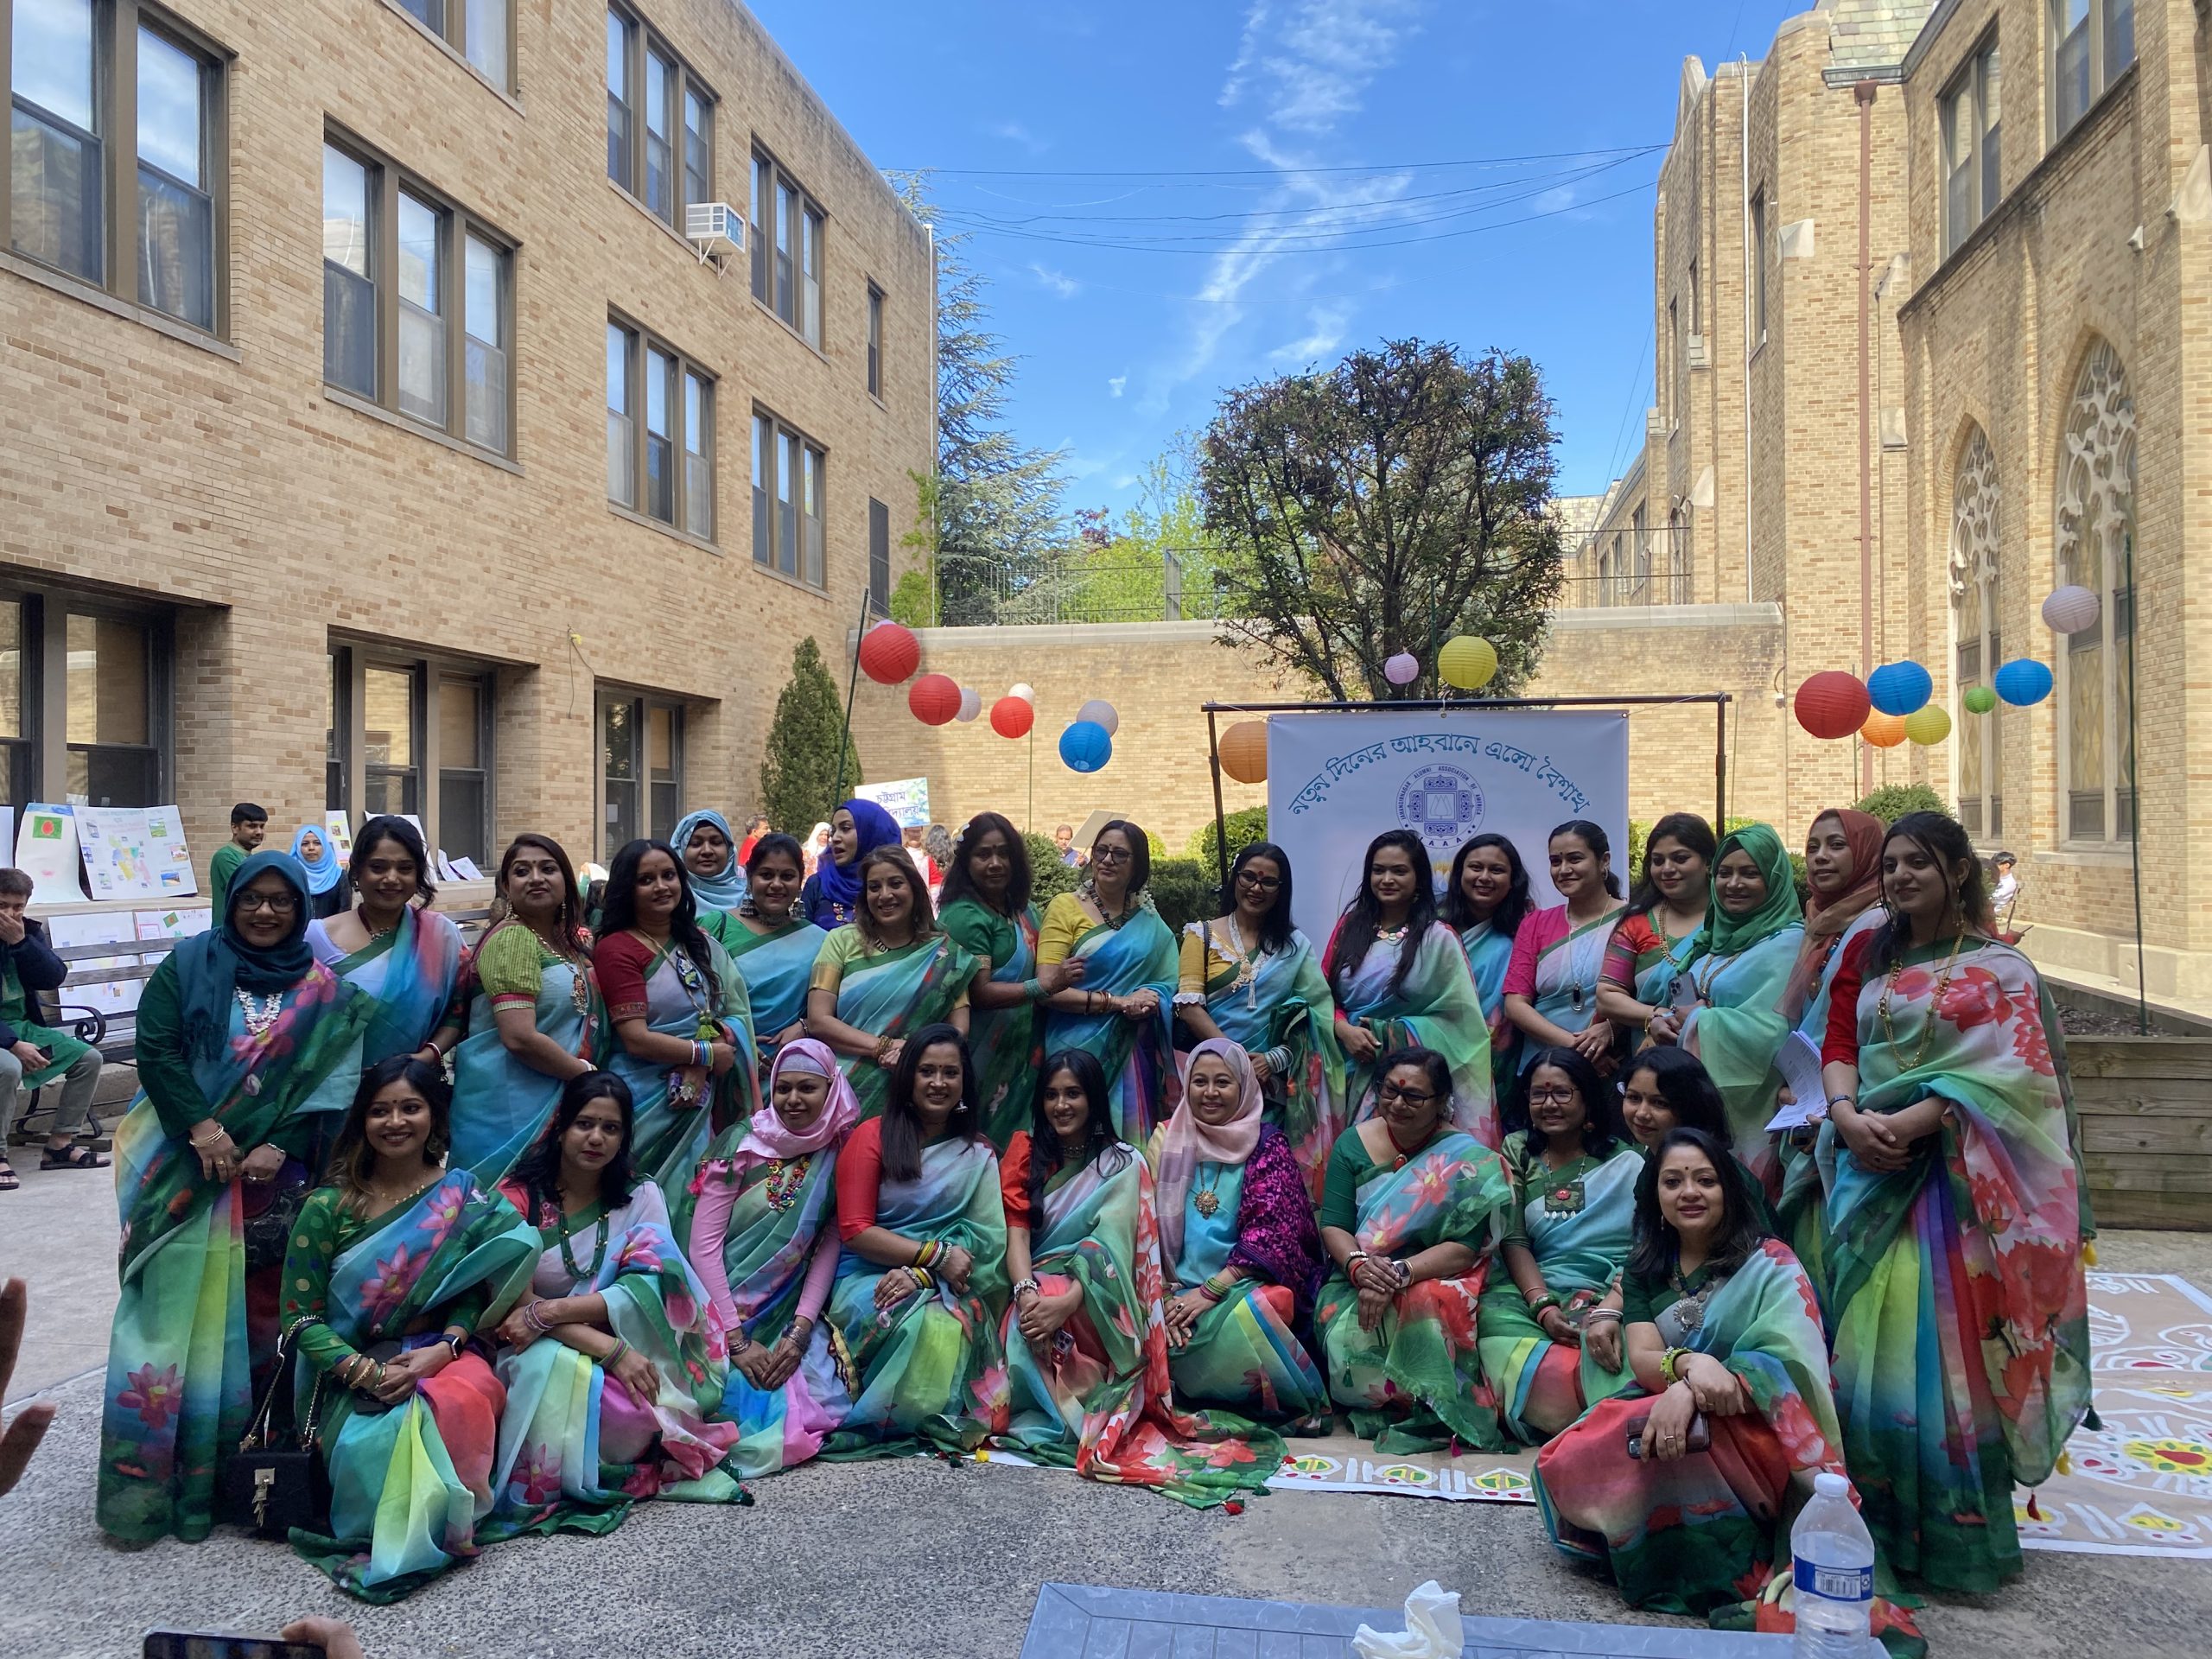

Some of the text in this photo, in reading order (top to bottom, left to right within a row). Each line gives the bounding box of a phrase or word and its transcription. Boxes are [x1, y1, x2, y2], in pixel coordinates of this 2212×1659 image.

[1288, 773, 1331, 814] নতুন
[1325, 741, 1387, 781] দিনের
[1484, 742, 1537, 772] এলো
[1536, 756, 1590, 813] বৈশাখ
[1397, 781, 1411, 820] JAHANGIRNAGAR
[1414, 766, 1432, 779] ALUMNI
[1438, 766, 1470, 781] ASSOCIATION
